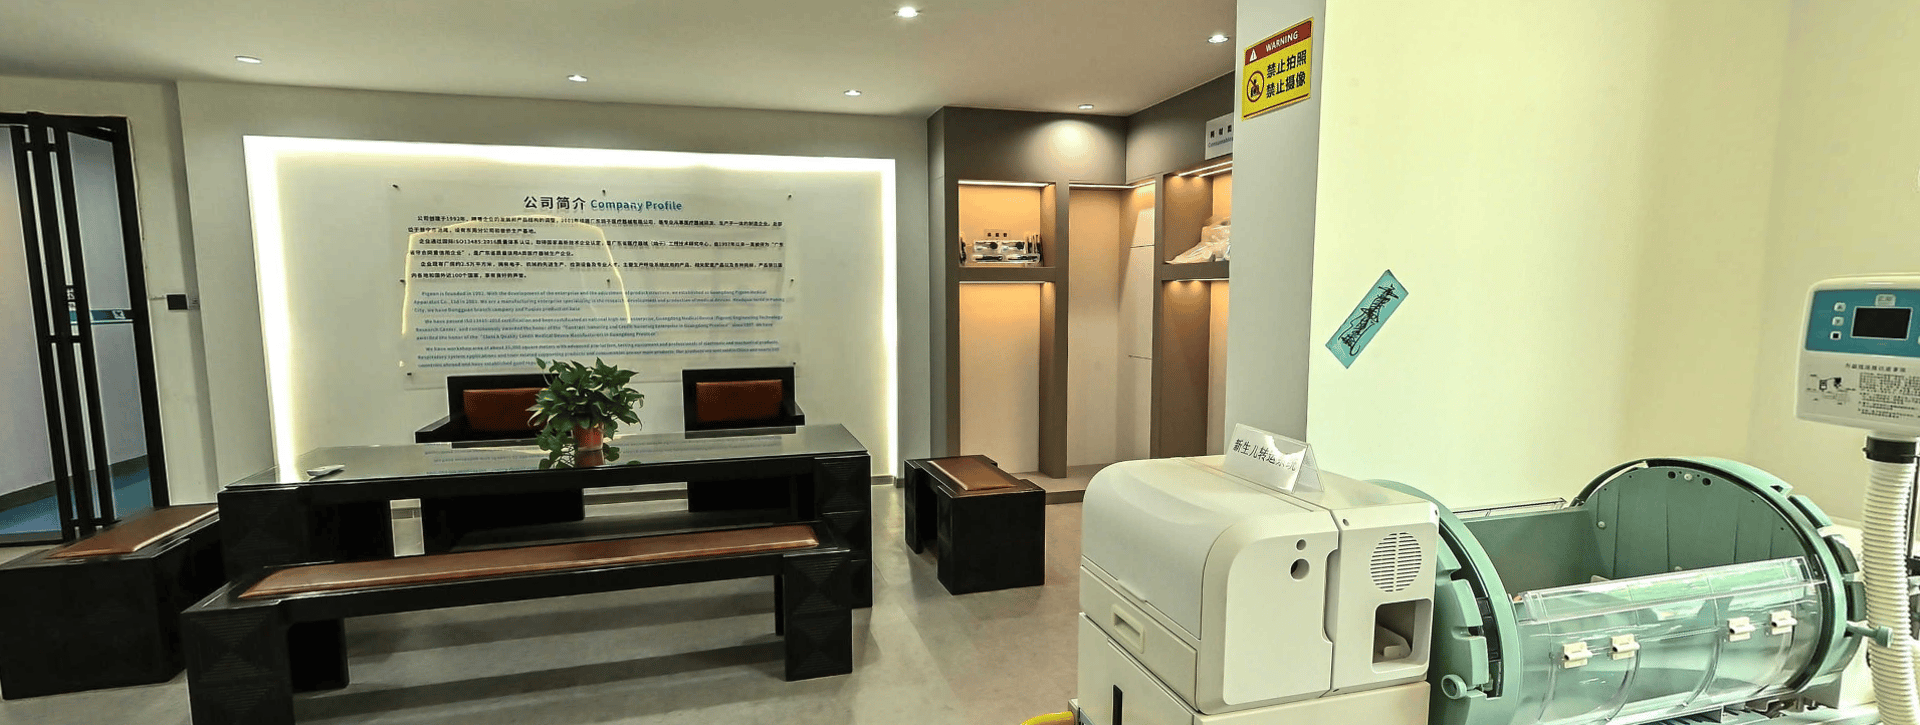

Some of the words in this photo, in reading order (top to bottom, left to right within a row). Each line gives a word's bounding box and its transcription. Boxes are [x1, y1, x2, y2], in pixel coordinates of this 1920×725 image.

[1265, 30, 1299, 53] WARNING
[1266, 49, 1307, 78] 禁止拍照
[1266, 70, 1306, 99] 禁止摄像
[523, 196, 586, 210] 公司简介
[590, 200, 642, 212] Company
[646, 200, 682, 210] Profile
